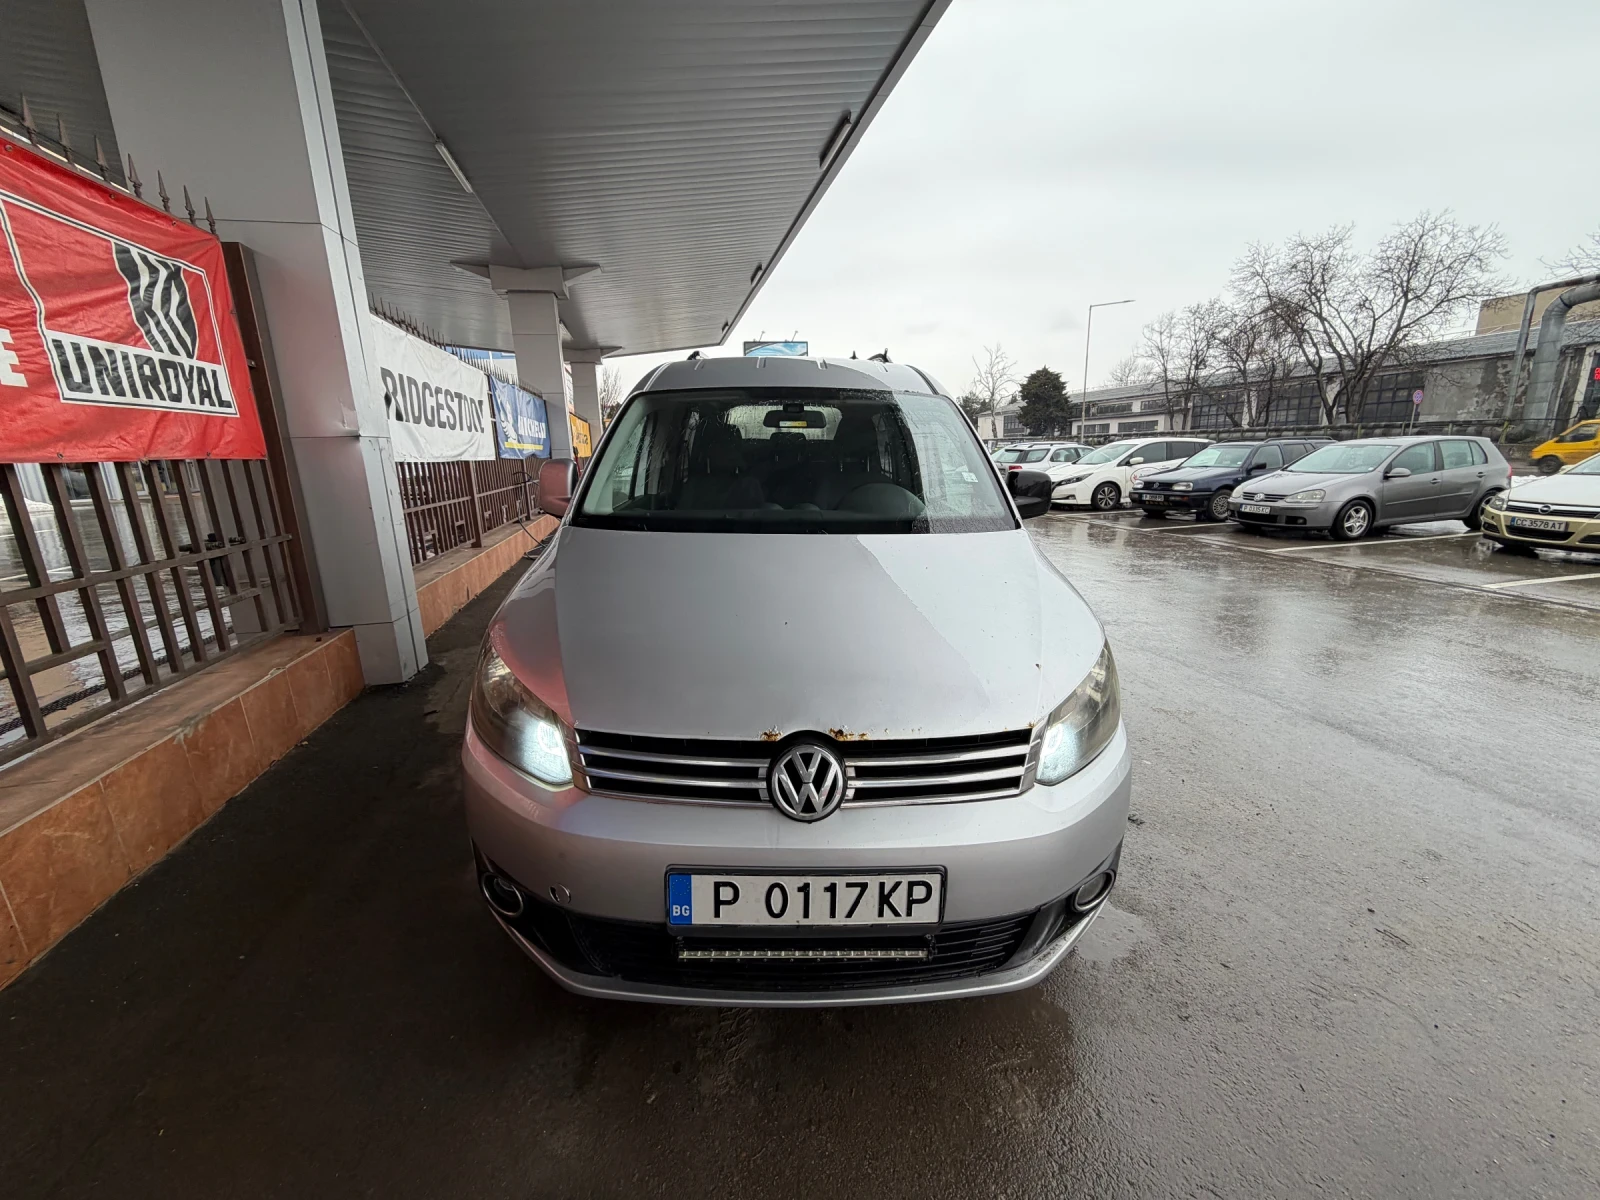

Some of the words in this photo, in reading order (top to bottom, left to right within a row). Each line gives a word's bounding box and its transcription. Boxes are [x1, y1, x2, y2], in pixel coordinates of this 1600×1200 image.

[52, 338, 233, 408] UNIROYAL
[672, 904, 690, 917] BG
[713, 881, 740, 919] P
